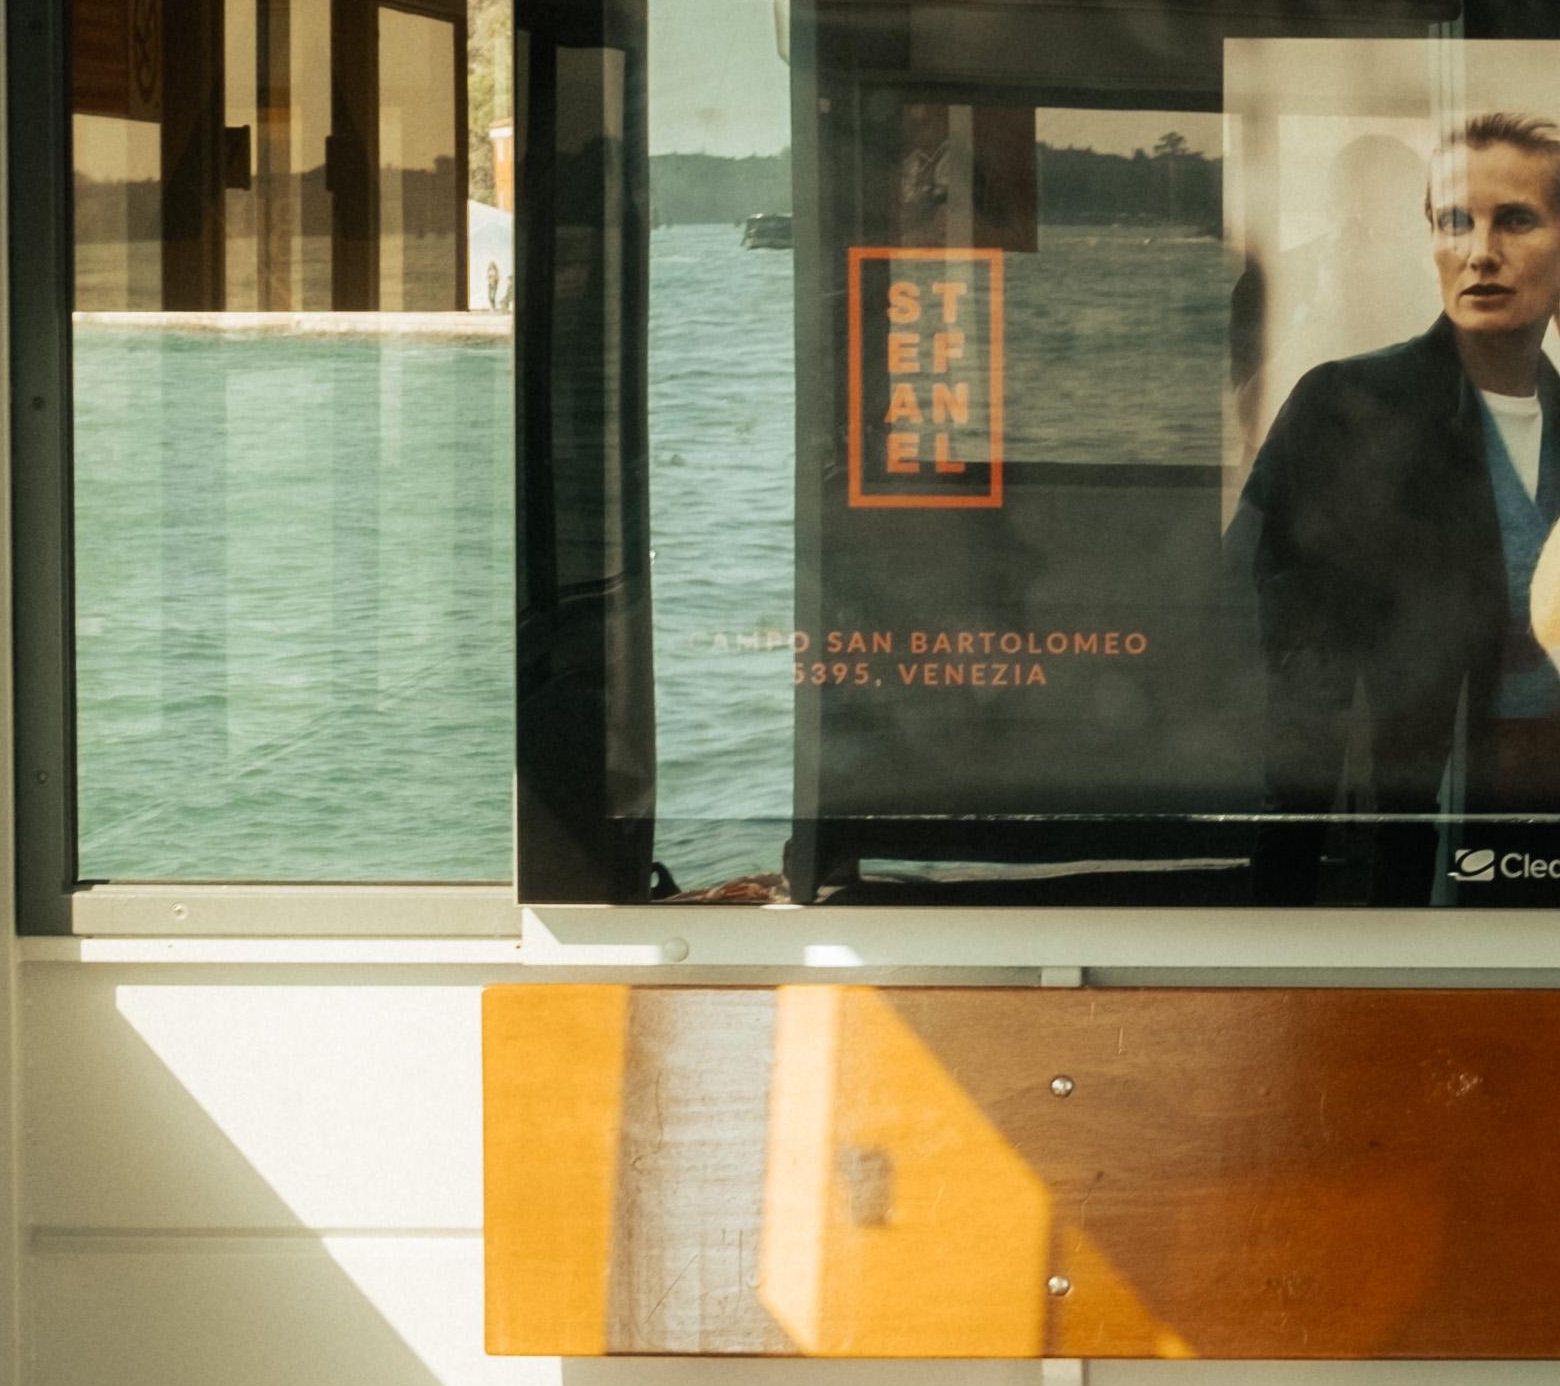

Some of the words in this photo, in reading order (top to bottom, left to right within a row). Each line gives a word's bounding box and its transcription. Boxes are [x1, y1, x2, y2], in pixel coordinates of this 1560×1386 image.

[827, 632, 893, 654] SAN
[910, 631, 1148, 655] BARTOLOMEO
[792, 662, 883, 688] 5395,
[898, 663, 1047, 686] VENEZIA
